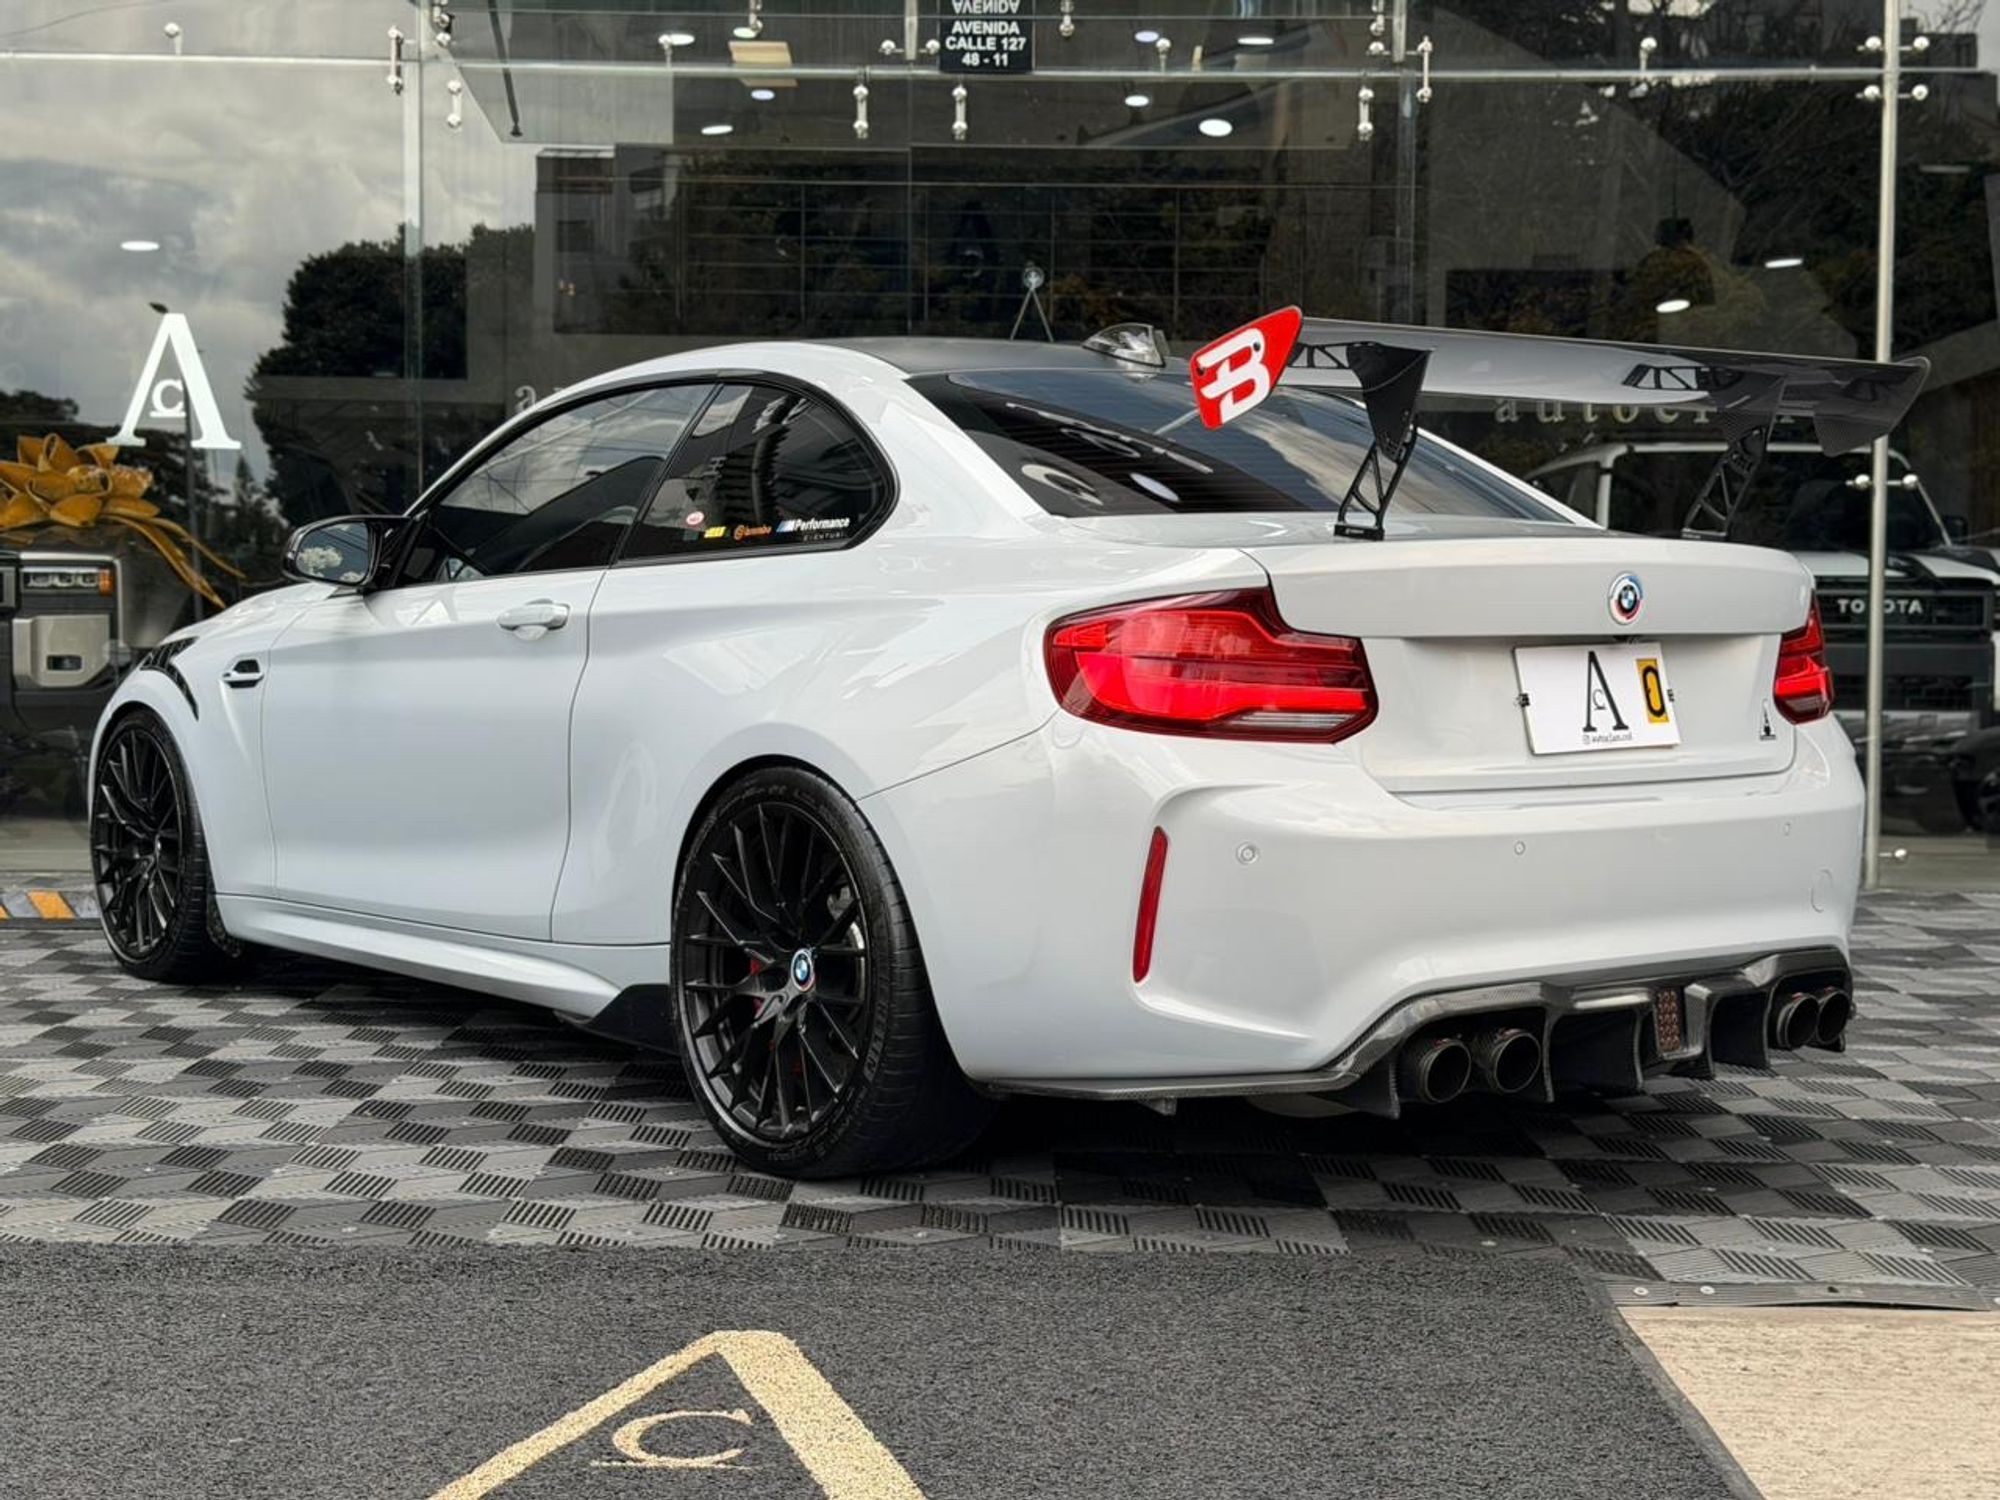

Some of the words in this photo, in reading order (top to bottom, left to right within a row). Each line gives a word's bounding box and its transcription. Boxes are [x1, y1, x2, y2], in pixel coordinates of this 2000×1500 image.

[951, 20, 1020, 35] AVENIDA
[945, 36, 997, 51] CALLE
[1001, 37, 1026, 51] 127
[962, 52, 980, 66] 48
[993, 52, 1009, 67] 11
[794, 516, 850, 531] Performance
[1837, 599, 1924, 615] TOOTA
